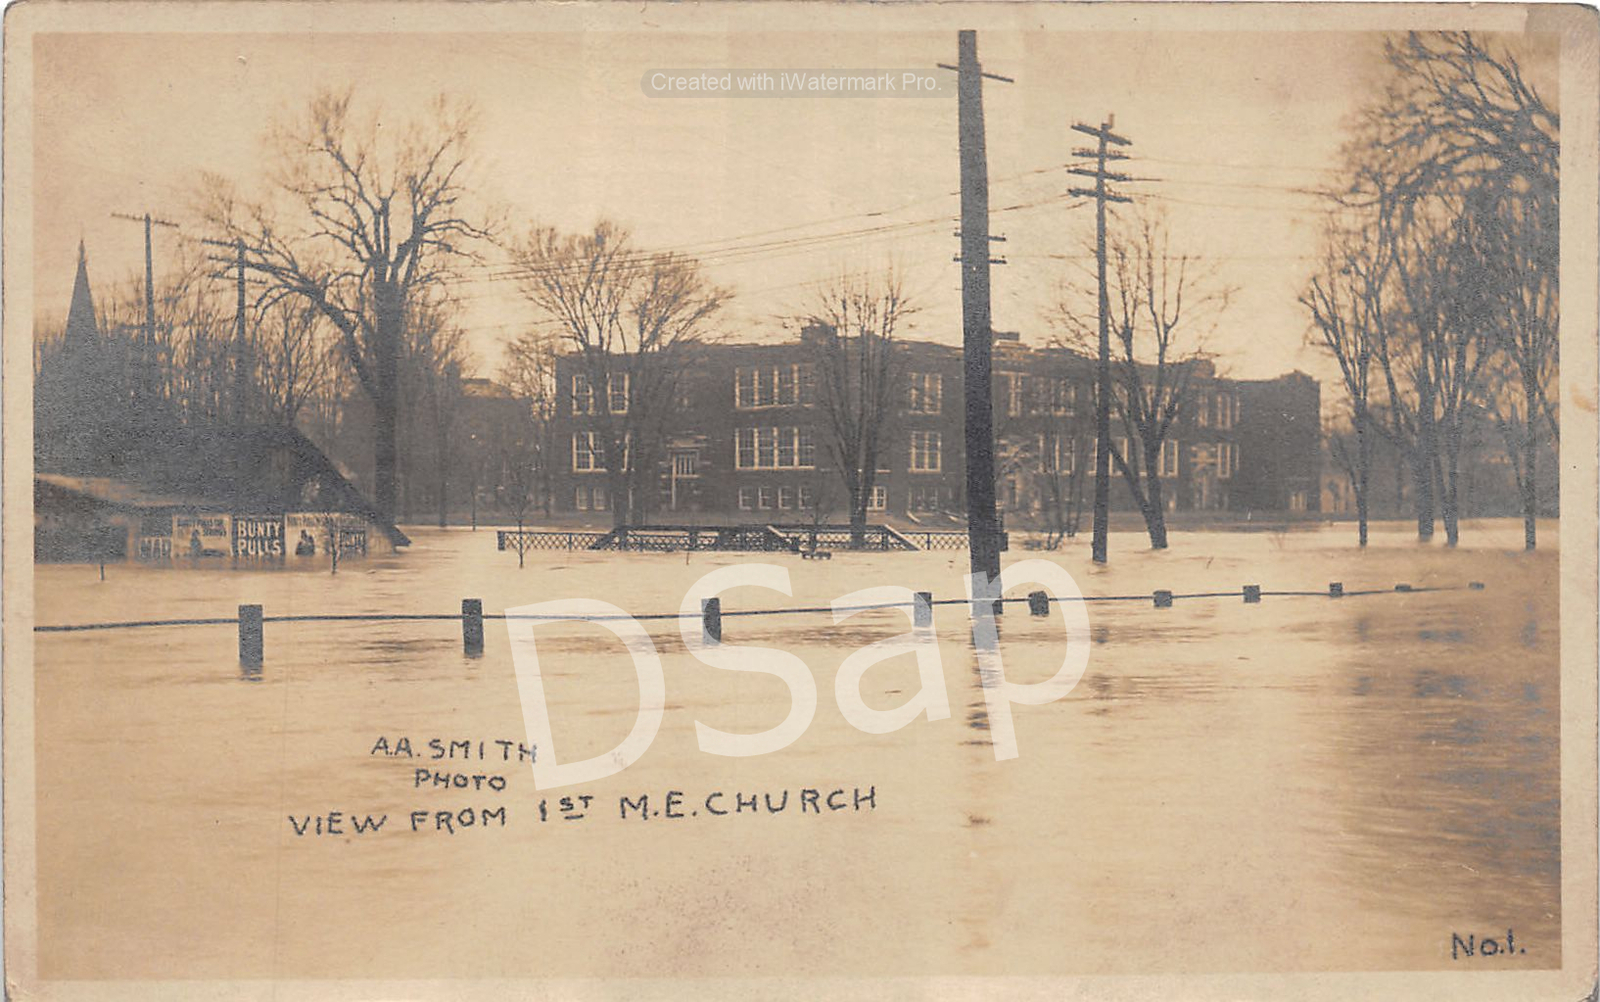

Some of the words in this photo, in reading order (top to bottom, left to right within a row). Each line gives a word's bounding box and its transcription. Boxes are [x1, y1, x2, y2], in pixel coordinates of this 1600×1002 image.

[237, 520, 281, 538] BUNTY
[237, 539, 281, 556] PULLS
[428, 738, 537, 764] SMITH
[415, 769, 507, 792] PHOTO
[288, 812, 388, 836] VIEW
[410, 807, 507, 834] FROM
[704, 786, 877, 815] CHURCH
